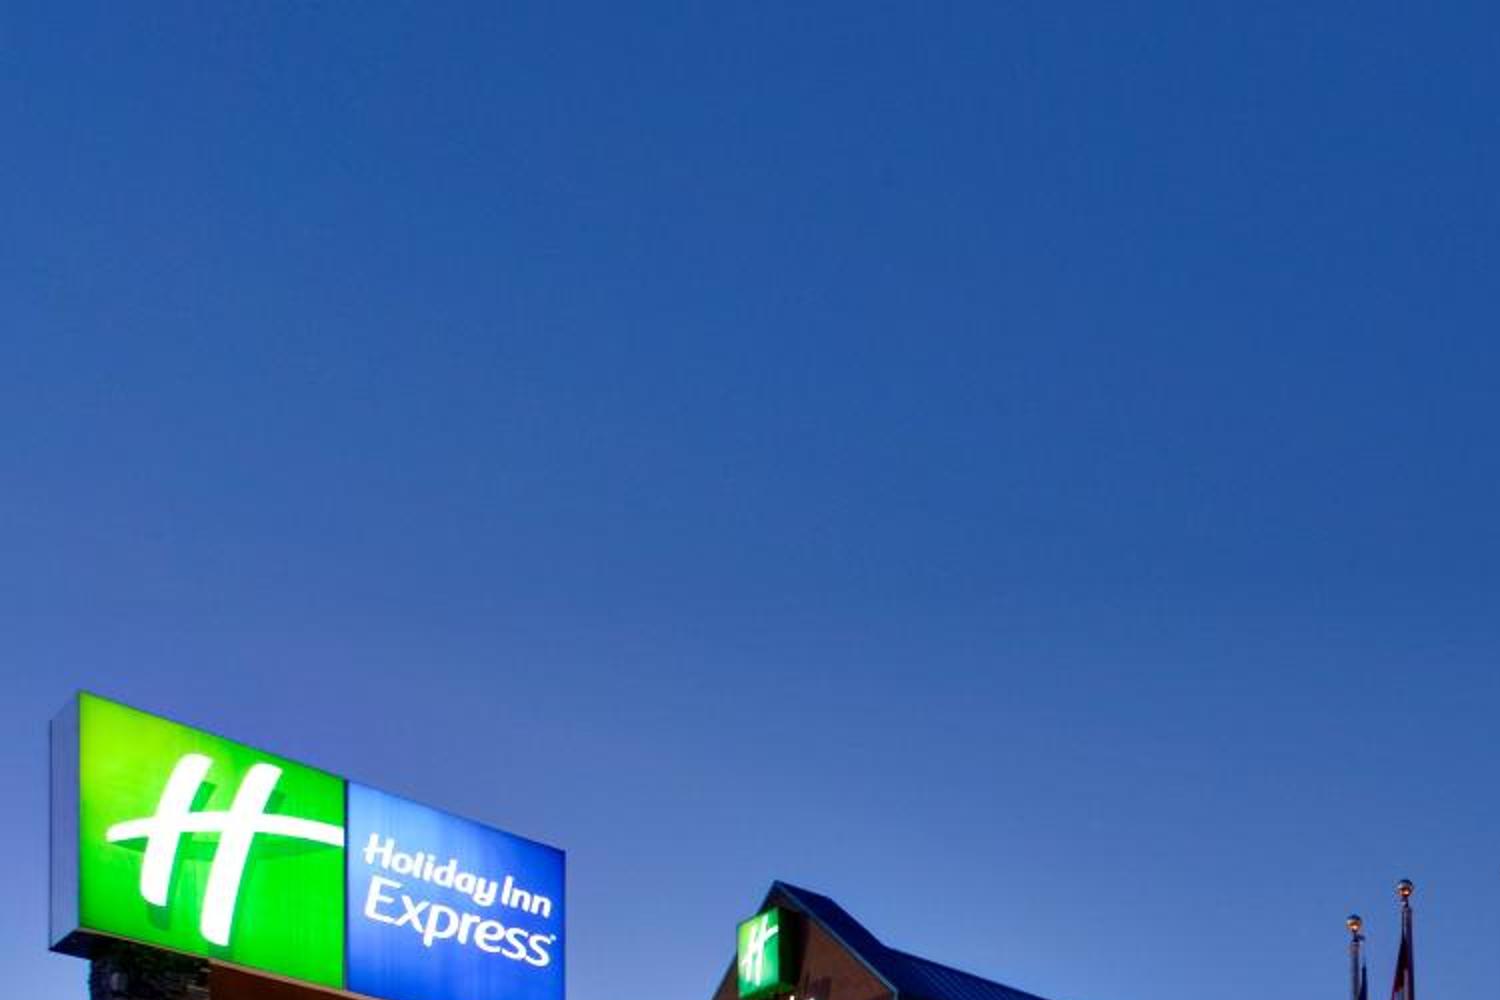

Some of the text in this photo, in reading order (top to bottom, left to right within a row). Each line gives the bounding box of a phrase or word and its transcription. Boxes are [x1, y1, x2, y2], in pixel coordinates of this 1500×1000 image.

[363, 833, 552, 918] Holiday Inn
[365, 875, 551, 967] Express
